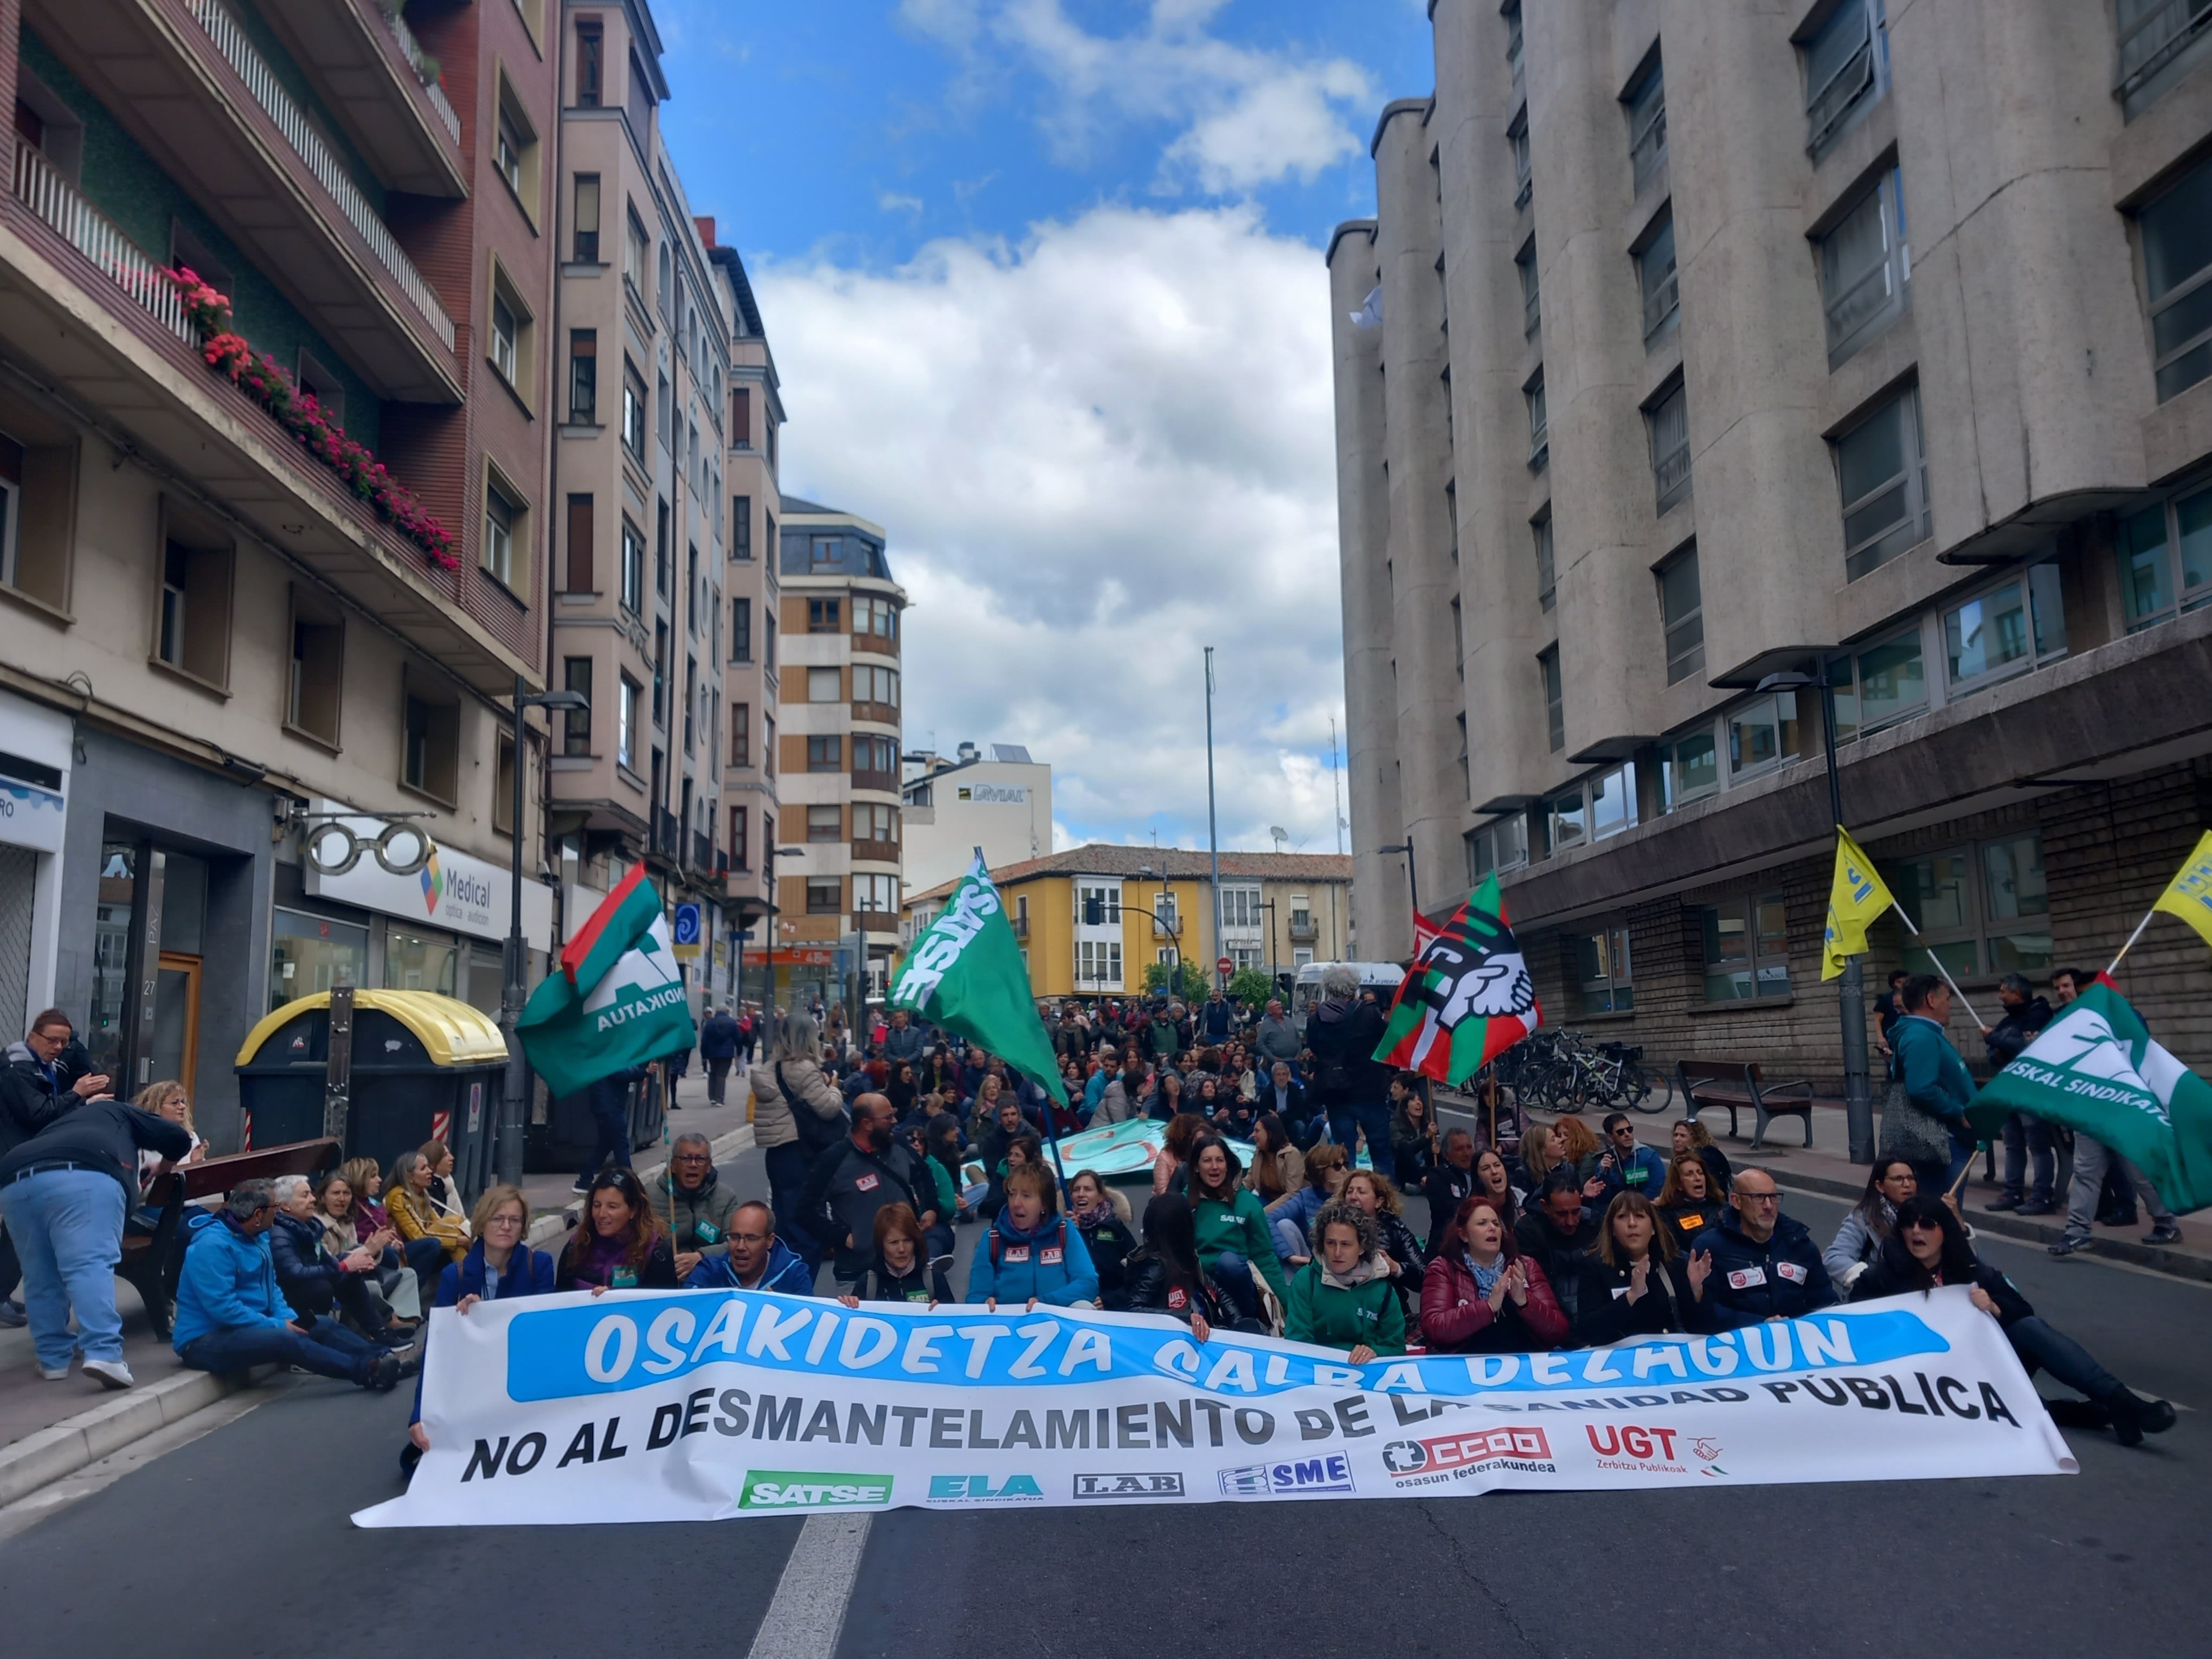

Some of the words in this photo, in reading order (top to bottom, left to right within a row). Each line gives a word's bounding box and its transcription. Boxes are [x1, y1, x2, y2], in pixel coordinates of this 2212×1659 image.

[447, 867, 490, 908] Medical
[148, 904, 159, 944] PAZ
[143, 980, 156, 995] 27
[1999, 1061, 2059, 1088] USKAL
[1008, 1249, 1027, 1257] LAB
[1041, 1250, 1060, 1259] LAB
[908, 1294, 930, 1302] SATS
[1356, 1307, 1378, 1321] STS
[583, 1298, 1112, 1384] OSAKIDETZA
[461, 1432, 548, 1483] NO
[556, 1416, 629, 1468] AL
[646, 1387, 1275, 1451] DESMANTELAMIENTO
[1293, 1394, 1377, 1441] DE
[1483, 1387, 1750, 1412] SANIDAD
[1760, 1372, 2023, 1429] PÚBLICA
[1432, 1432, 1541, 1465] CCOO
[1585, 1424, 1677, 1461] UGT
[1273, 1455, 1348, 1486] SME
[1396, 1472, 1450, 1488] osasun
[1453, 1459, 1557, 1480] federakundea
[1596, 1459, 1637, 1470] Zerbitzu
[1639, 1462, 1688, 1474] Publikoak
[749, 1482, 886, 1506] SATSE
[928, 1475, 1044, 1498] ELA
[1082, 1476, 1178, 1493] LAB
